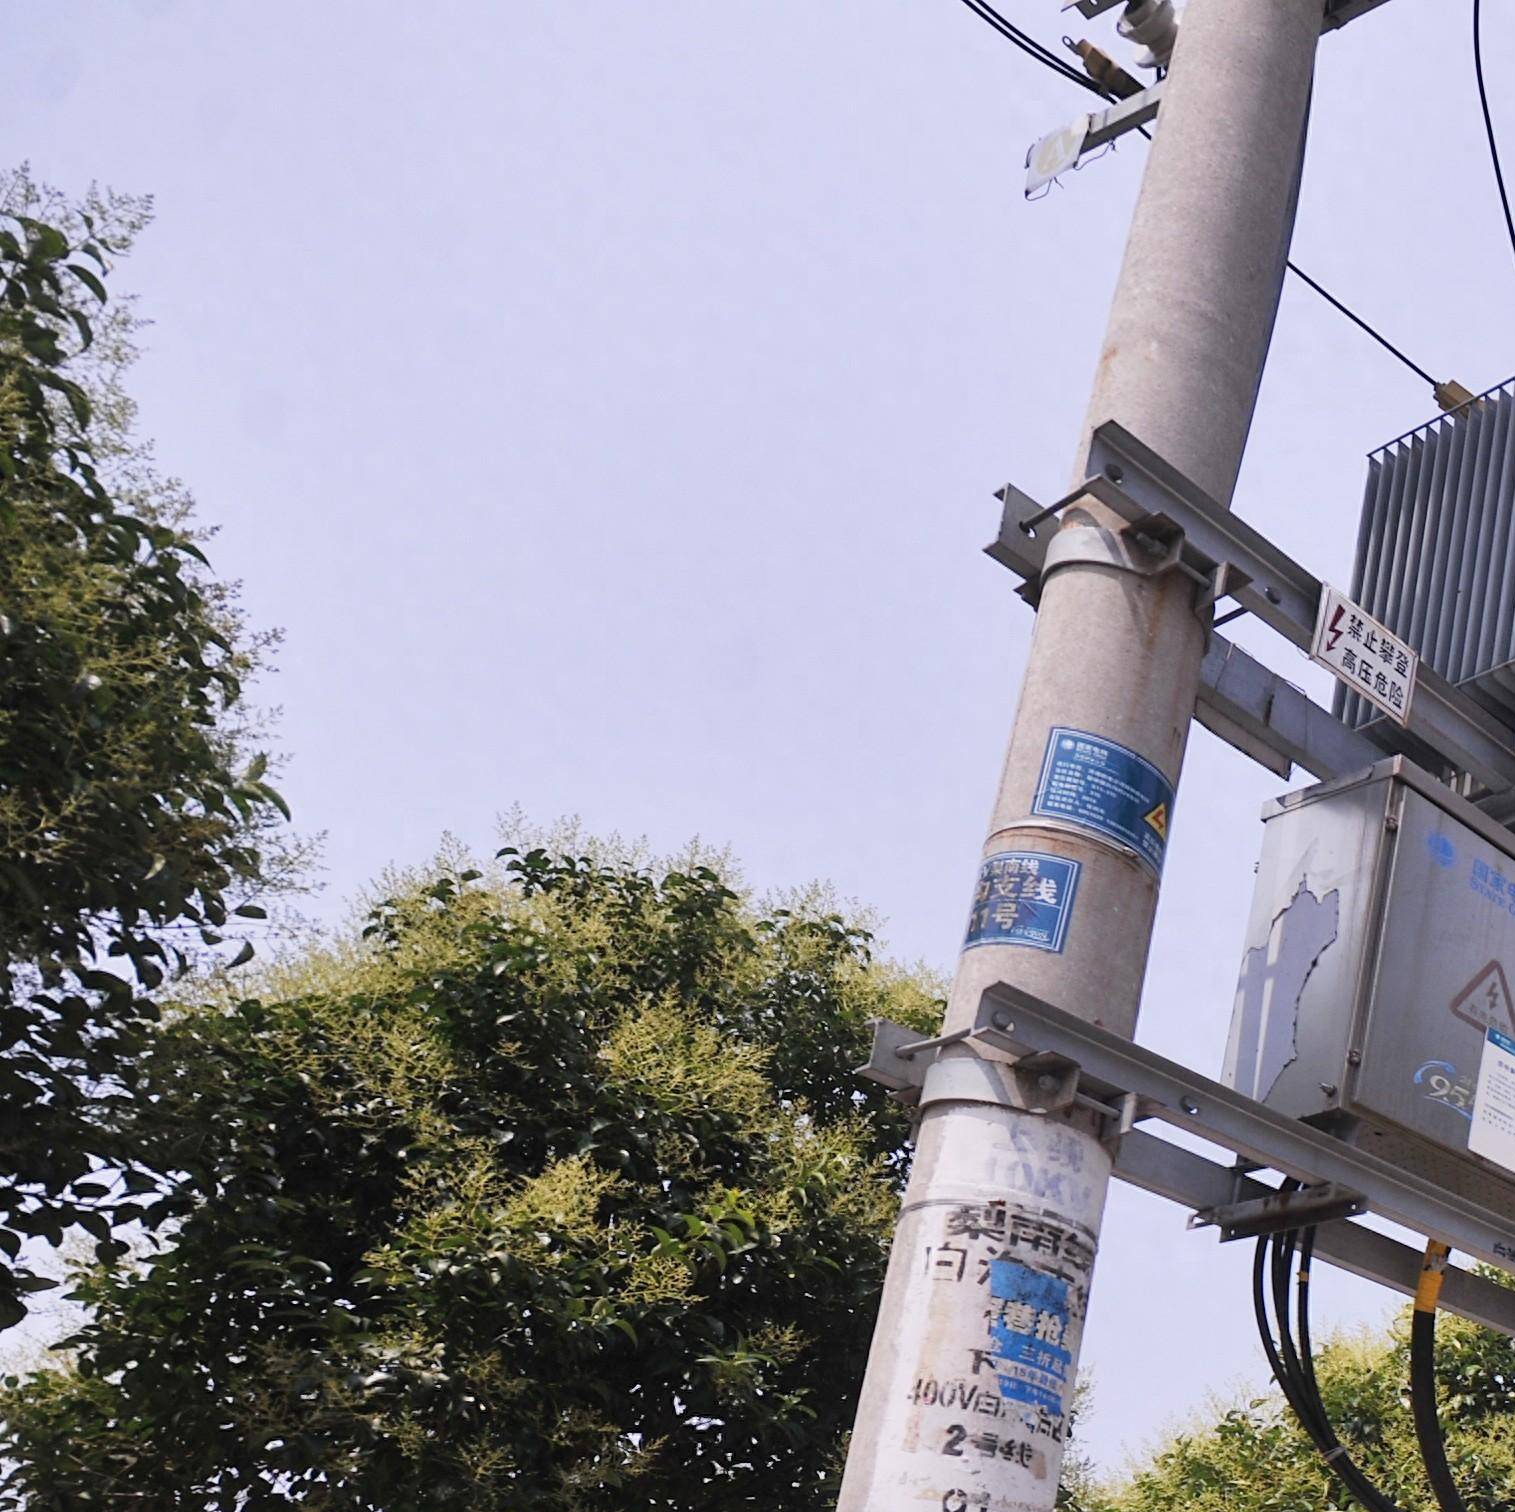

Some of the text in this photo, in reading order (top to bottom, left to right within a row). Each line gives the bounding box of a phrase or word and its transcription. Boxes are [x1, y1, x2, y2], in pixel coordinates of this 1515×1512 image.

[1348, 614, 1408, 679] 禁止攀登
[1342, 647, 1404, 710] 高压危险
[1429, 1074, 1475, 1108] 95
[942, 1424, 1033, 1468] 2号线
